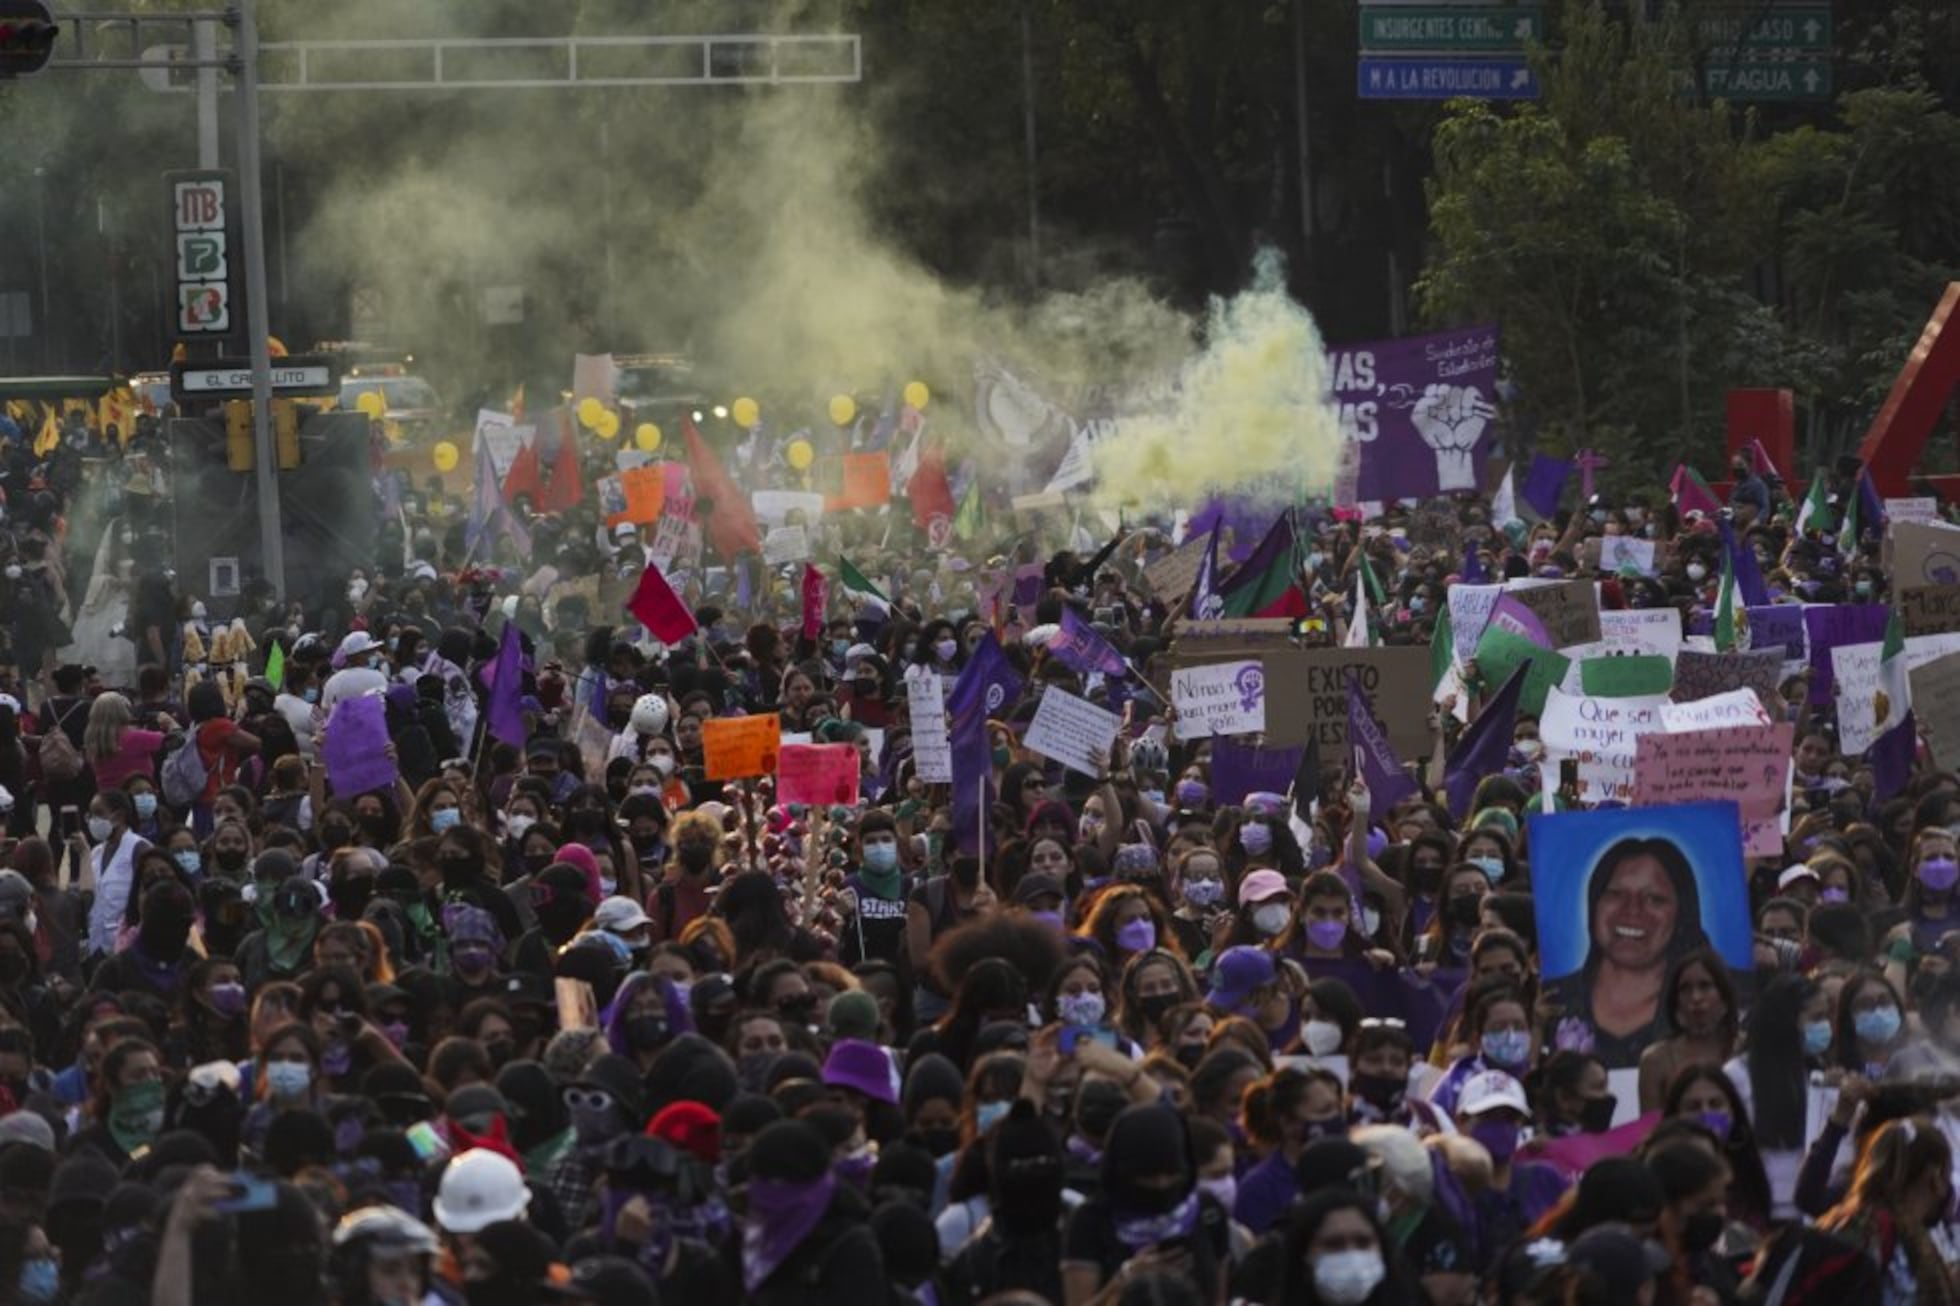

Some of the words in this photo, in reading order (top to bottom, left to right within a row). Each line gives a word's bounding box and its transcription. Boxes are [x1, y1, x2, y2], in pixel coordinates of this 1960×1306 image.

[1373, 17, 1455, 40] INSURGENTES
[1384, 68, 1396, 90] A
[1401, 67, 1419, 90] LA
[206, 374, 224, 386] EL
[1313, 695, 1378, 719] PORE
[1580, 699, 1619, 722] Que
